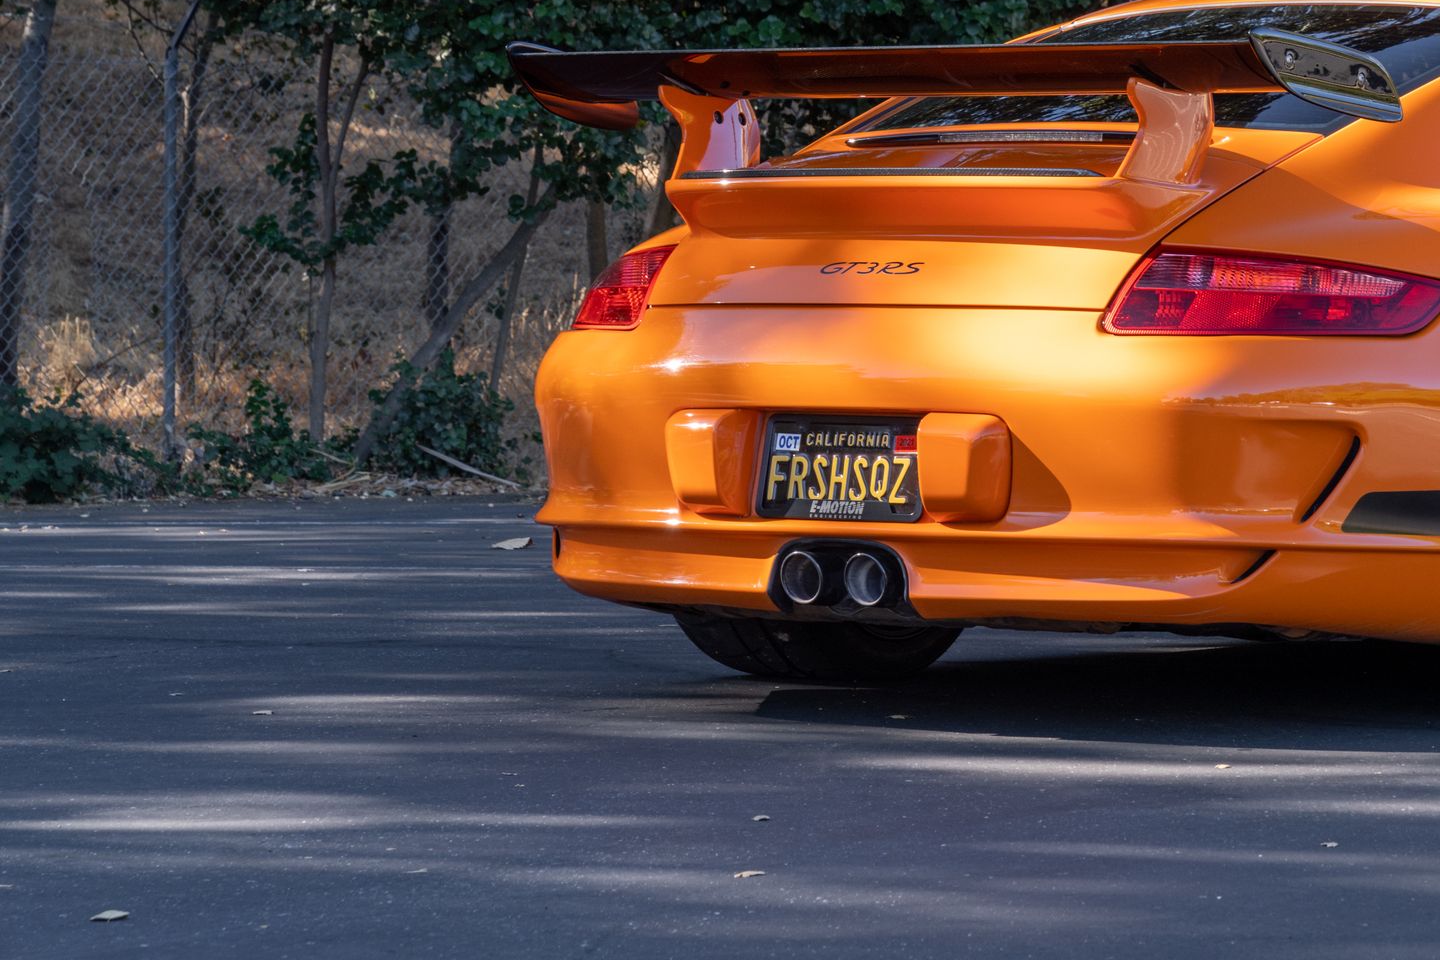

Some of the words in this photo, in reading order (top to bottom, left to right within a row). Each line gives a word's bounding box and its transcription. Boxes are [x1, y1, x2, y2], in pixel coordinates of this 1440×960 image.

[778, 435, 800, 449] OCT
[806, 432, 889, 447] CALIFORNIA
[766, 455, 911, 504] FRSHSQZ
[809, 500, 865, 515] E-MOTION
